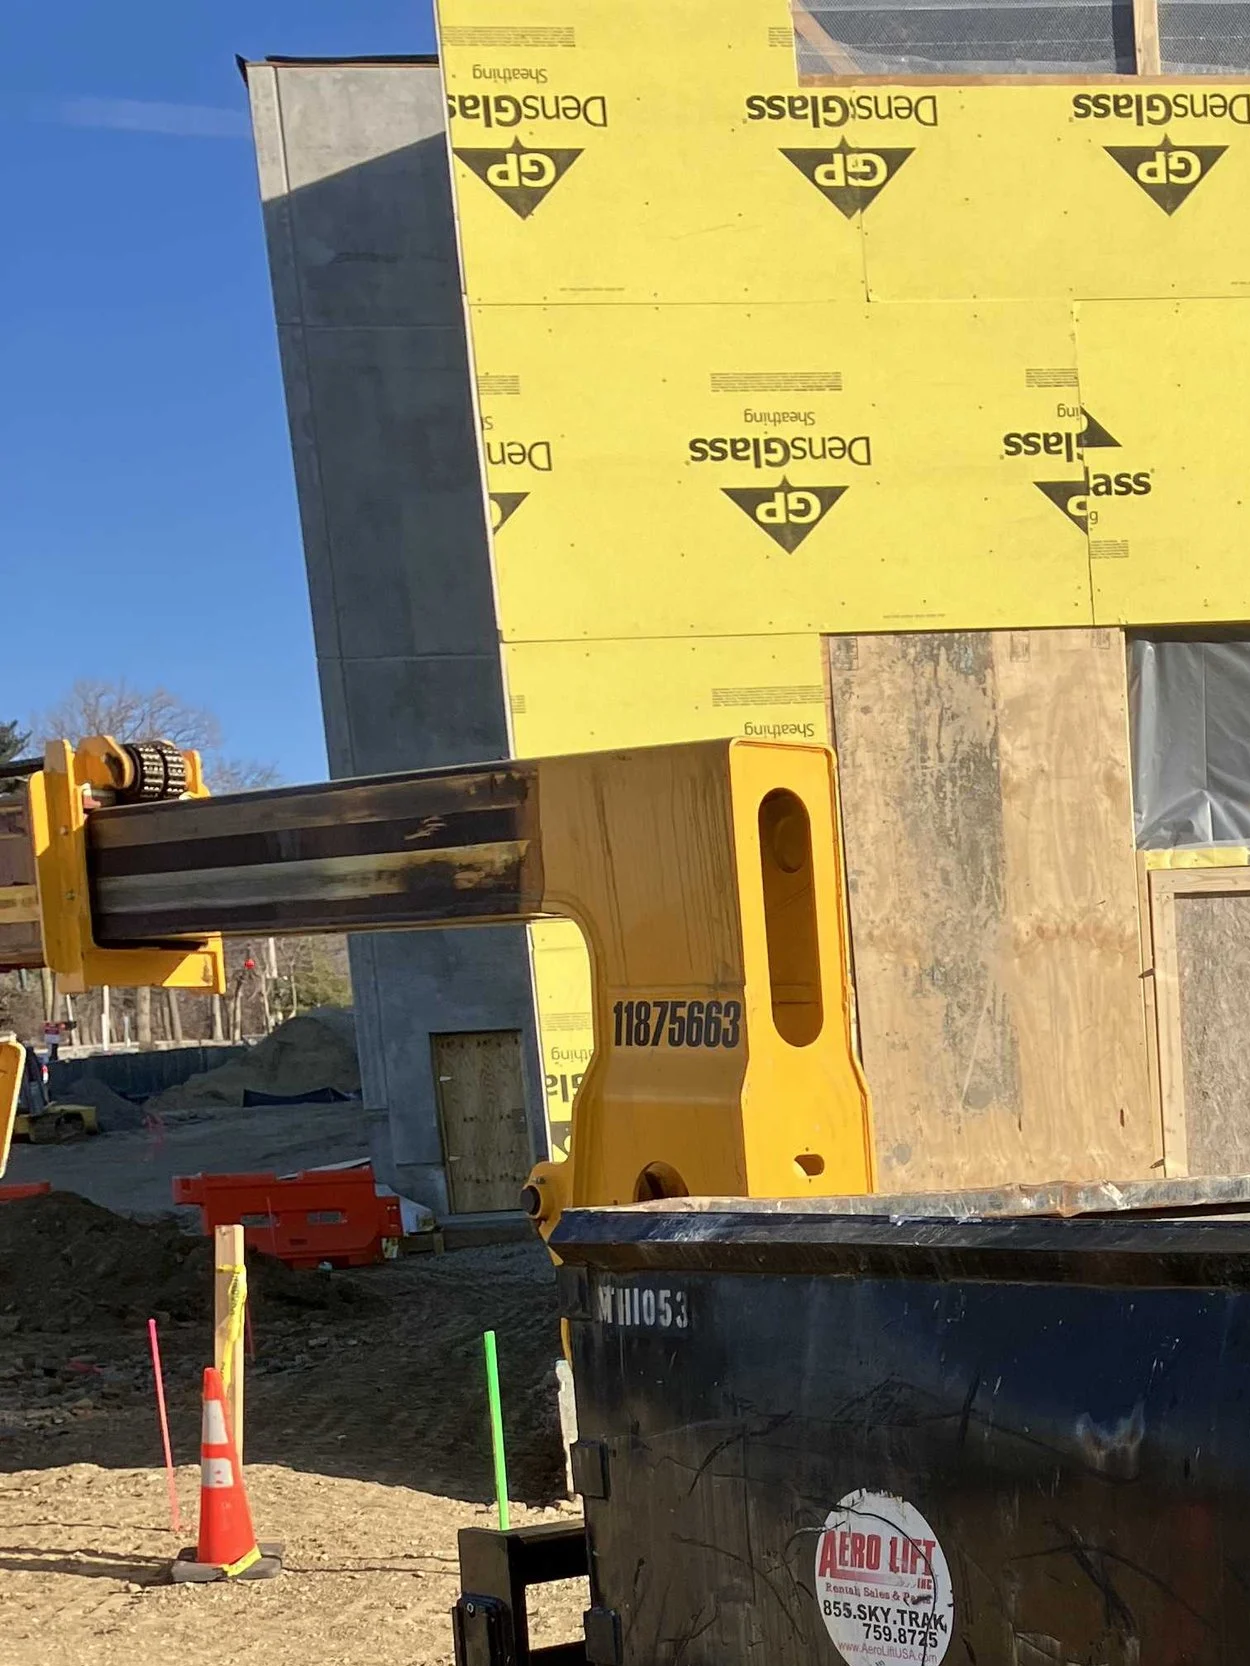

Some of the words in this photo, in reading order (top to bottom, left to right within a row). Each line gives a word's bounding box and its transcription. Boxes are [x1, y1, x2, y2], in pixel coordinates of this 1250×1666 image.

[472, 64, 548, 84] Sheathing
[486, 152, 557, 188] GP
[814, 153, 888, 188] GP
[1136, 150, 1202, 185] GP
[744, 409, 815, 426] Sheathing
[755, 491, 822, 524] GP
[744, 721, 815, 738] Sheathing
[613, 1000, 742, 1048] 11875663
[818, 1530, 882, 1578] AERO
[889, 1536, 936, 1576] LIFT
[863, 1584, 890, 1599] Sales
[891, 1590, 901, 1600] &
[917, 1578, 932, 1590] INC
[862, 1623, 938, 1648] 759.8725
[837, 1640, 938, 1664] www.AeroLiftUSA.com
